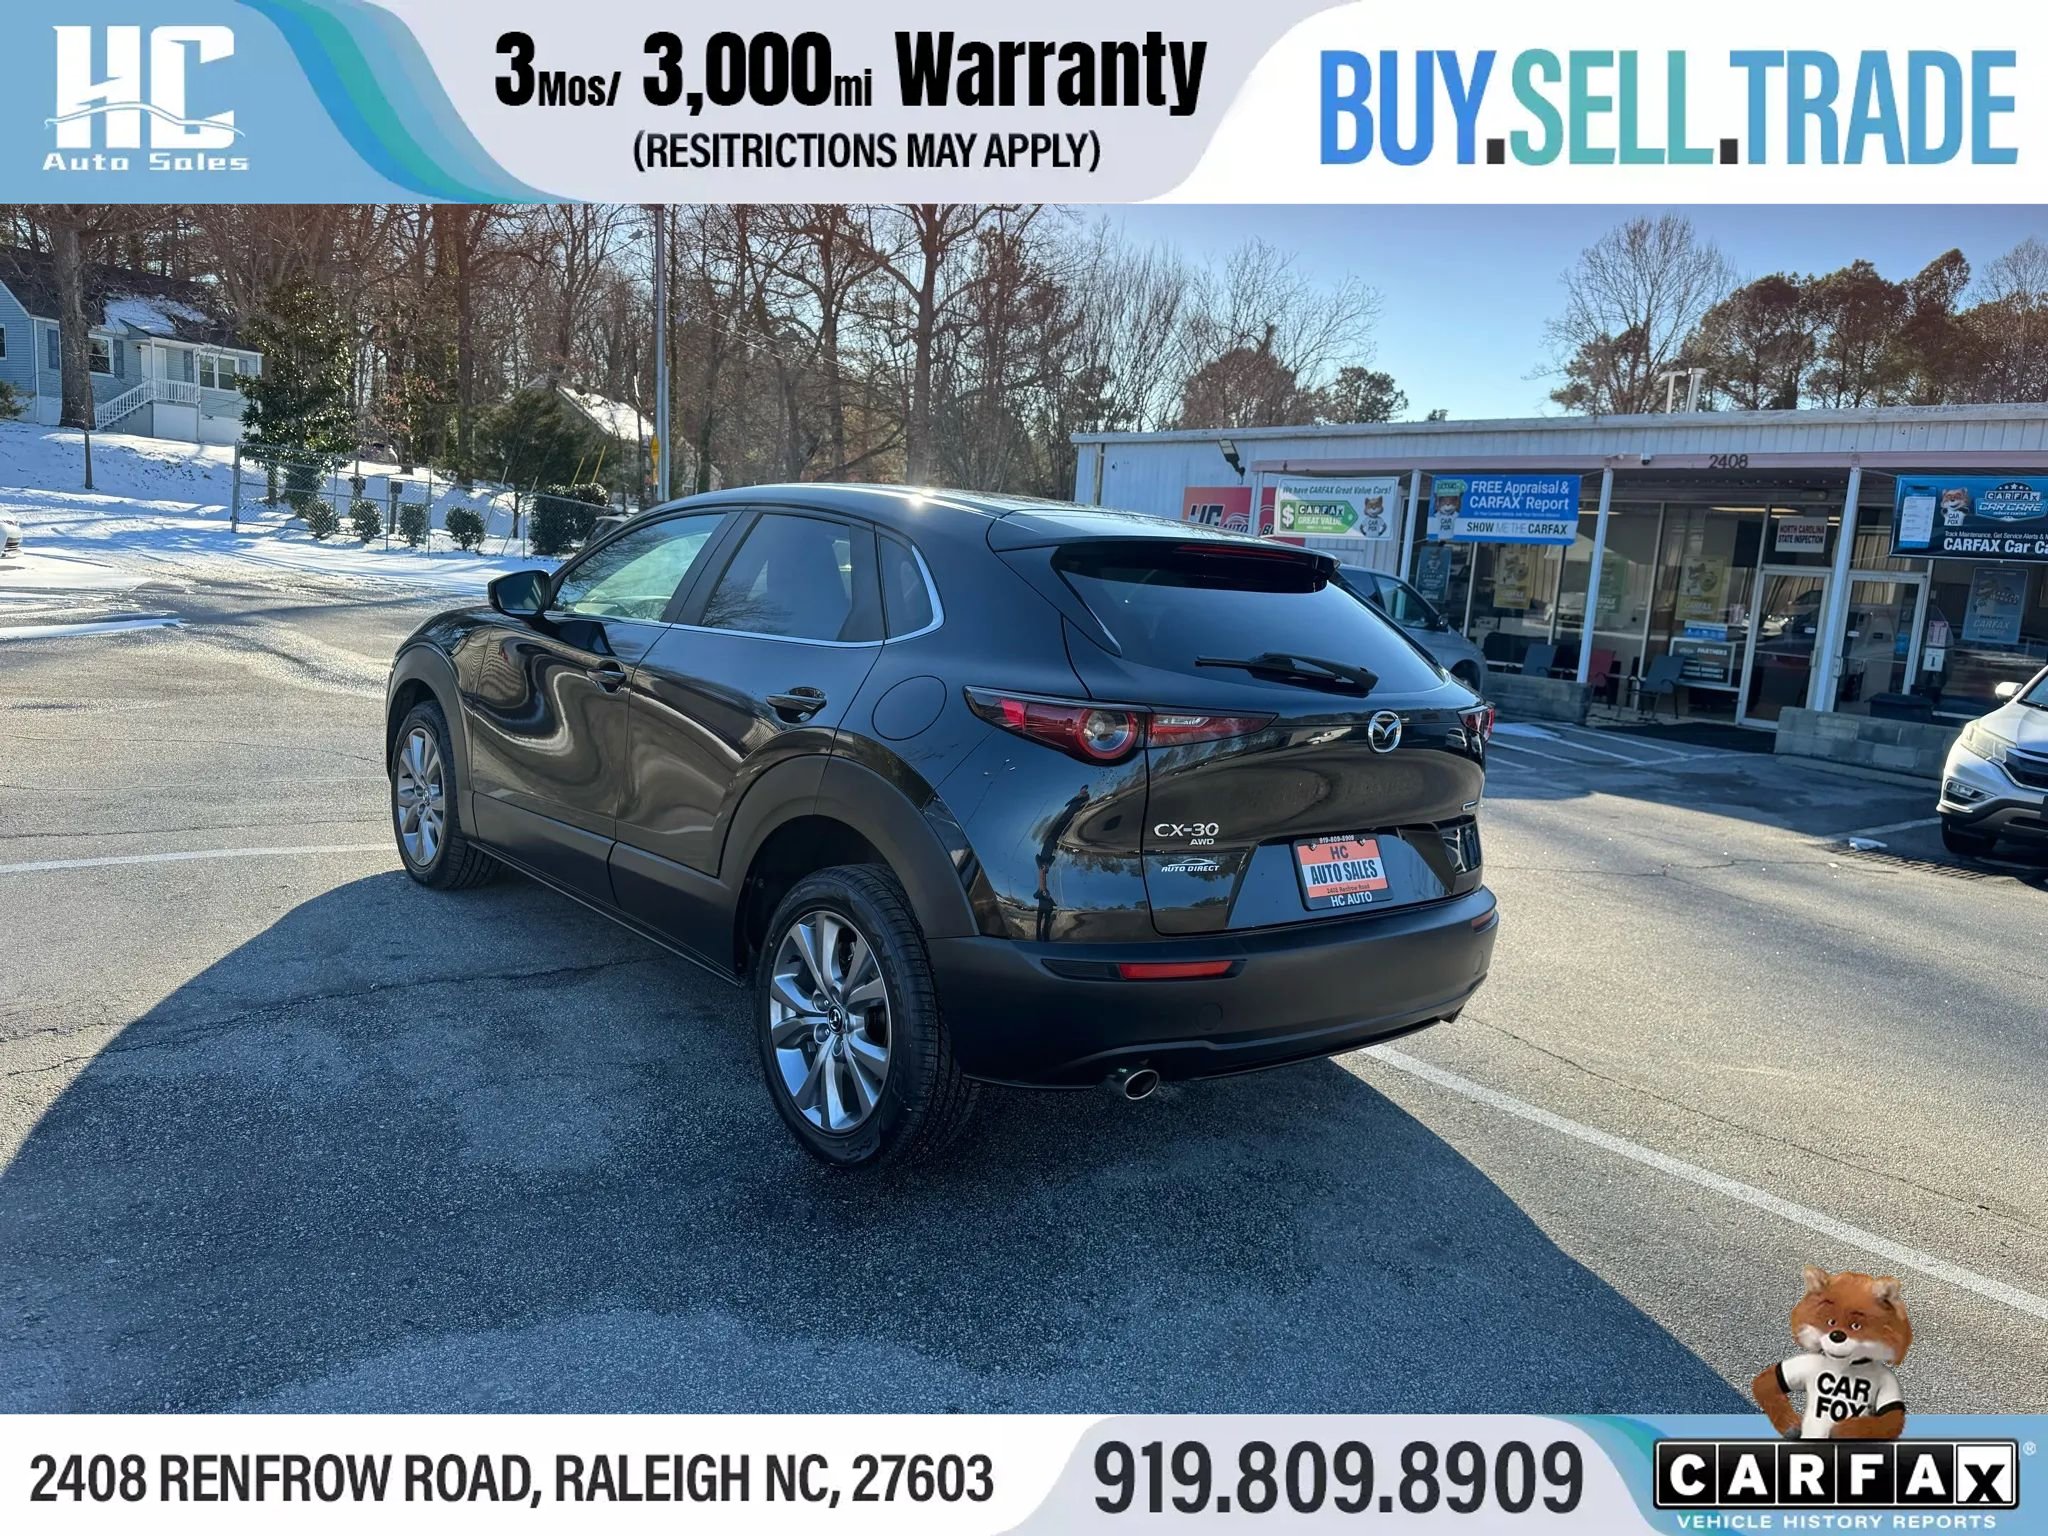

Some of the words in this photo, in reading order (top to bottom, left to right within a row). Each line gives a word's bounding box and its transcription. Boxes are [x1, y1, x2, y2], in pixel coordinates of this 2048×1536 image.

[1708, 454, 1749, 469] 2408
[1309, 486, 1335, 494] CARFAX
[1335, 486, 1354, 494] Great
[1354, 486, 1372, 494] Value
[1470, 480, 1503, 494] FREE
[1503, 481, 1559, 500] Appraisal
[1560, 481, 1569, 495] &
[1987, 492, 2040, 501] CARFAX
[1299, 505, 1344, 516] CARFAX
[1469, 495, 1521, 510] CARFAX
[1525, 496, 1569, 512] Report
[1979, 502, 2005, 511] CAR
[2006, 502, 2043, 512] CARE
[1297, 517, 1319, 525] GREAT
[1320, 517, 1343, 525] VALUE
[1466, 521, 1494, 533] SHOW
[1528, 523, 1569, 535] CARFAX
[1943, 538, 2000, 552] CARFAX
[2004, 539, 2031, 554] Car
[1153, 822, 1220, 837] CX-30
[1189, 838, 1215, 846] AWD
[1330, 845, 1349, 860] HC
[1310, 863, 1343, 885] AUTO
[1342, 859, 1378, 881] SALES
[1330, 895, 1346, 907] HC
[1347, 891, 1373, 905] AUTO
